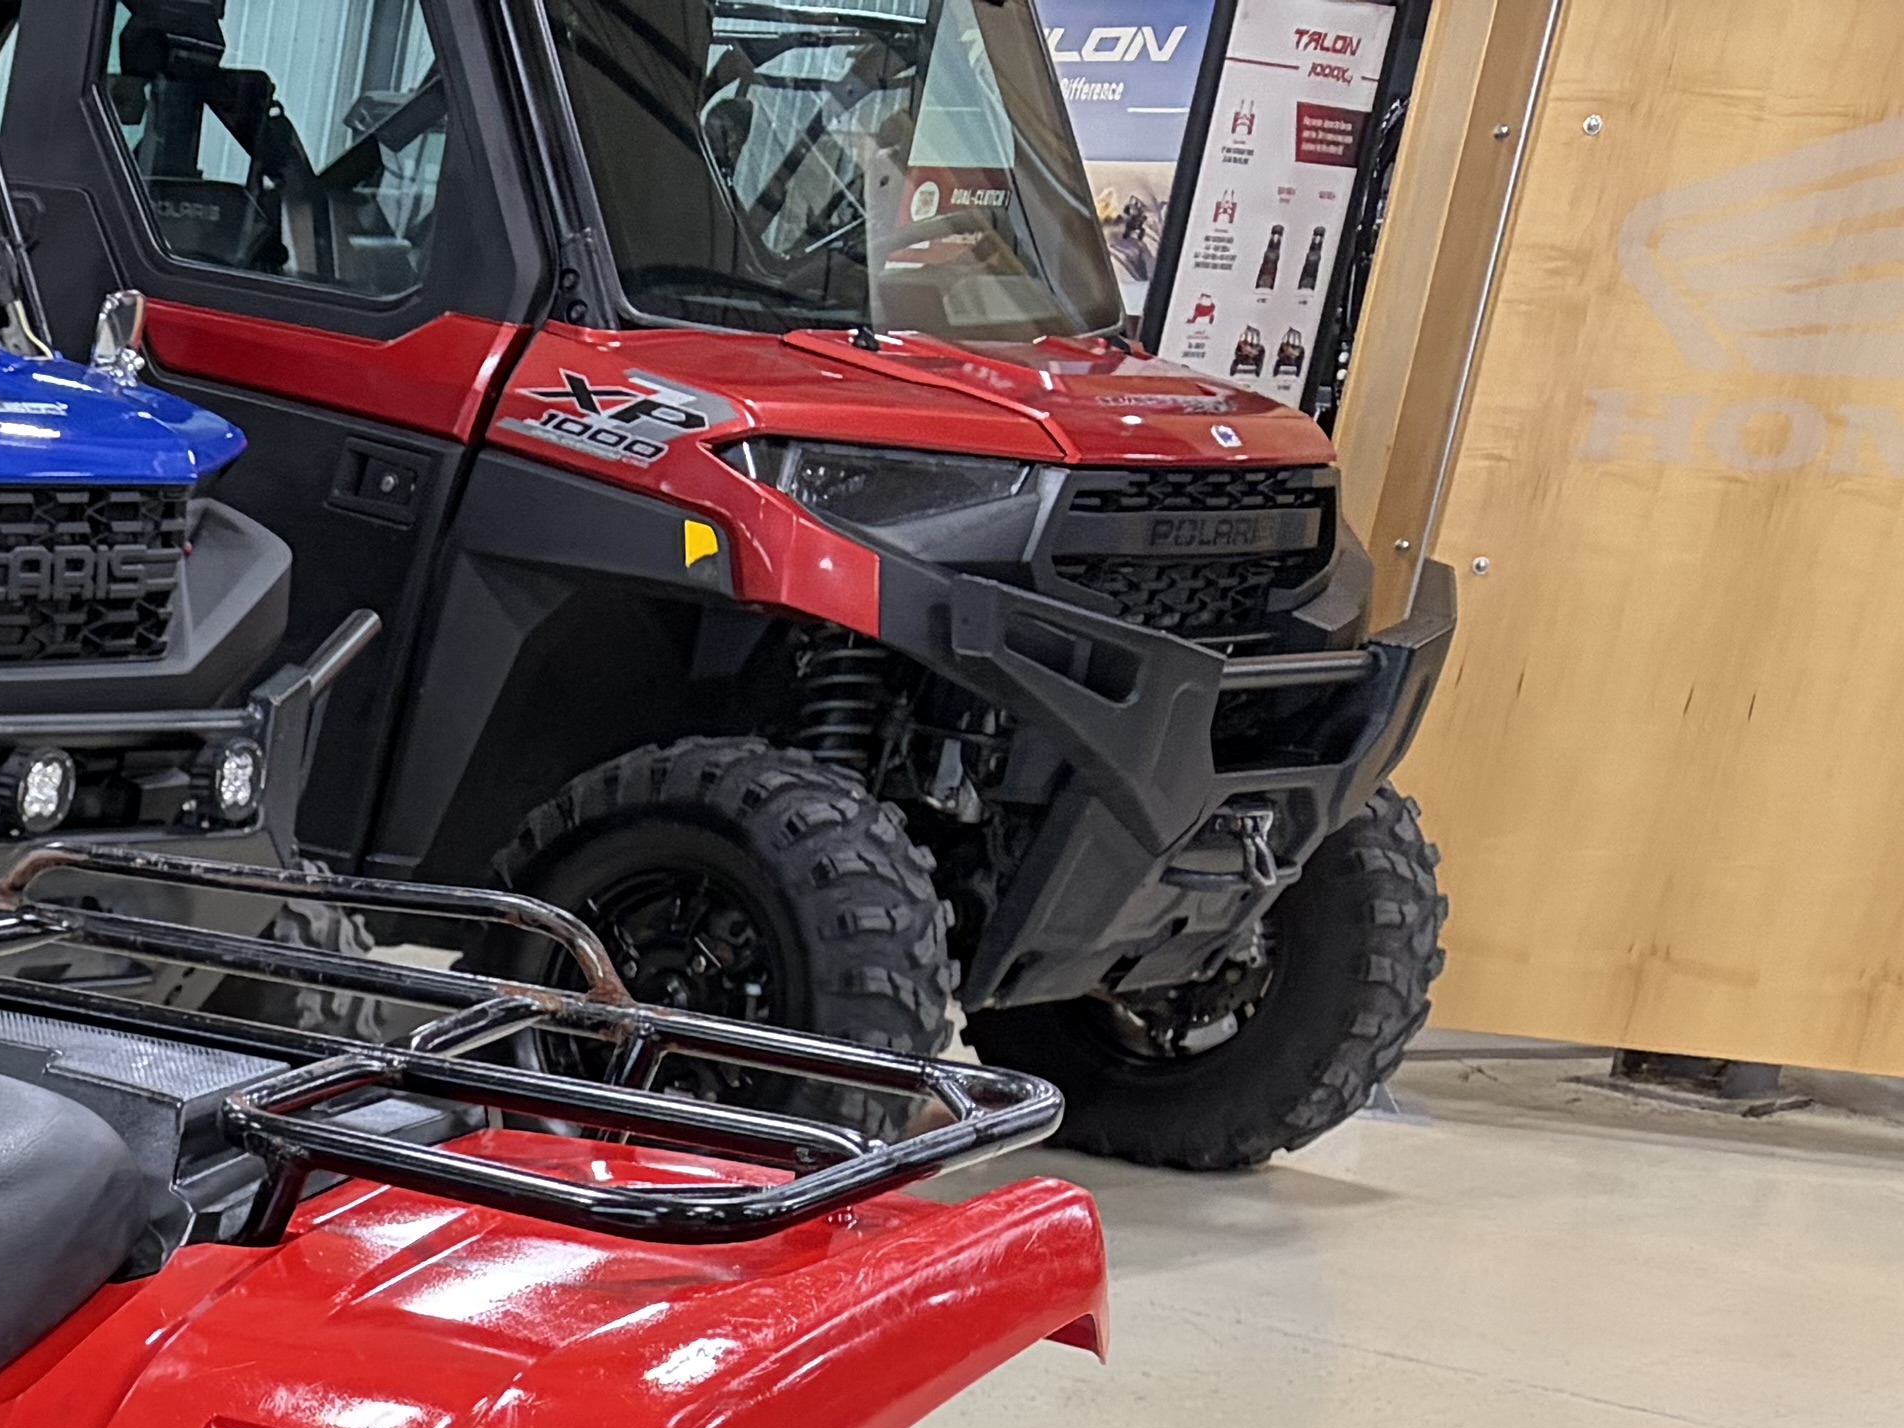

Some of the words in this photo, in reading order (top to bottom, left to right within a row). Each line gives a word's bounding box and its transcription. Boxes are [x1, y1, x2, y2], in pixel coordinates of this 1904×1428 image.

[1294, 28, 1361, 56] TALON
[515, 367, 709, 432] XP
[539, 408, 669, 463] 1000
